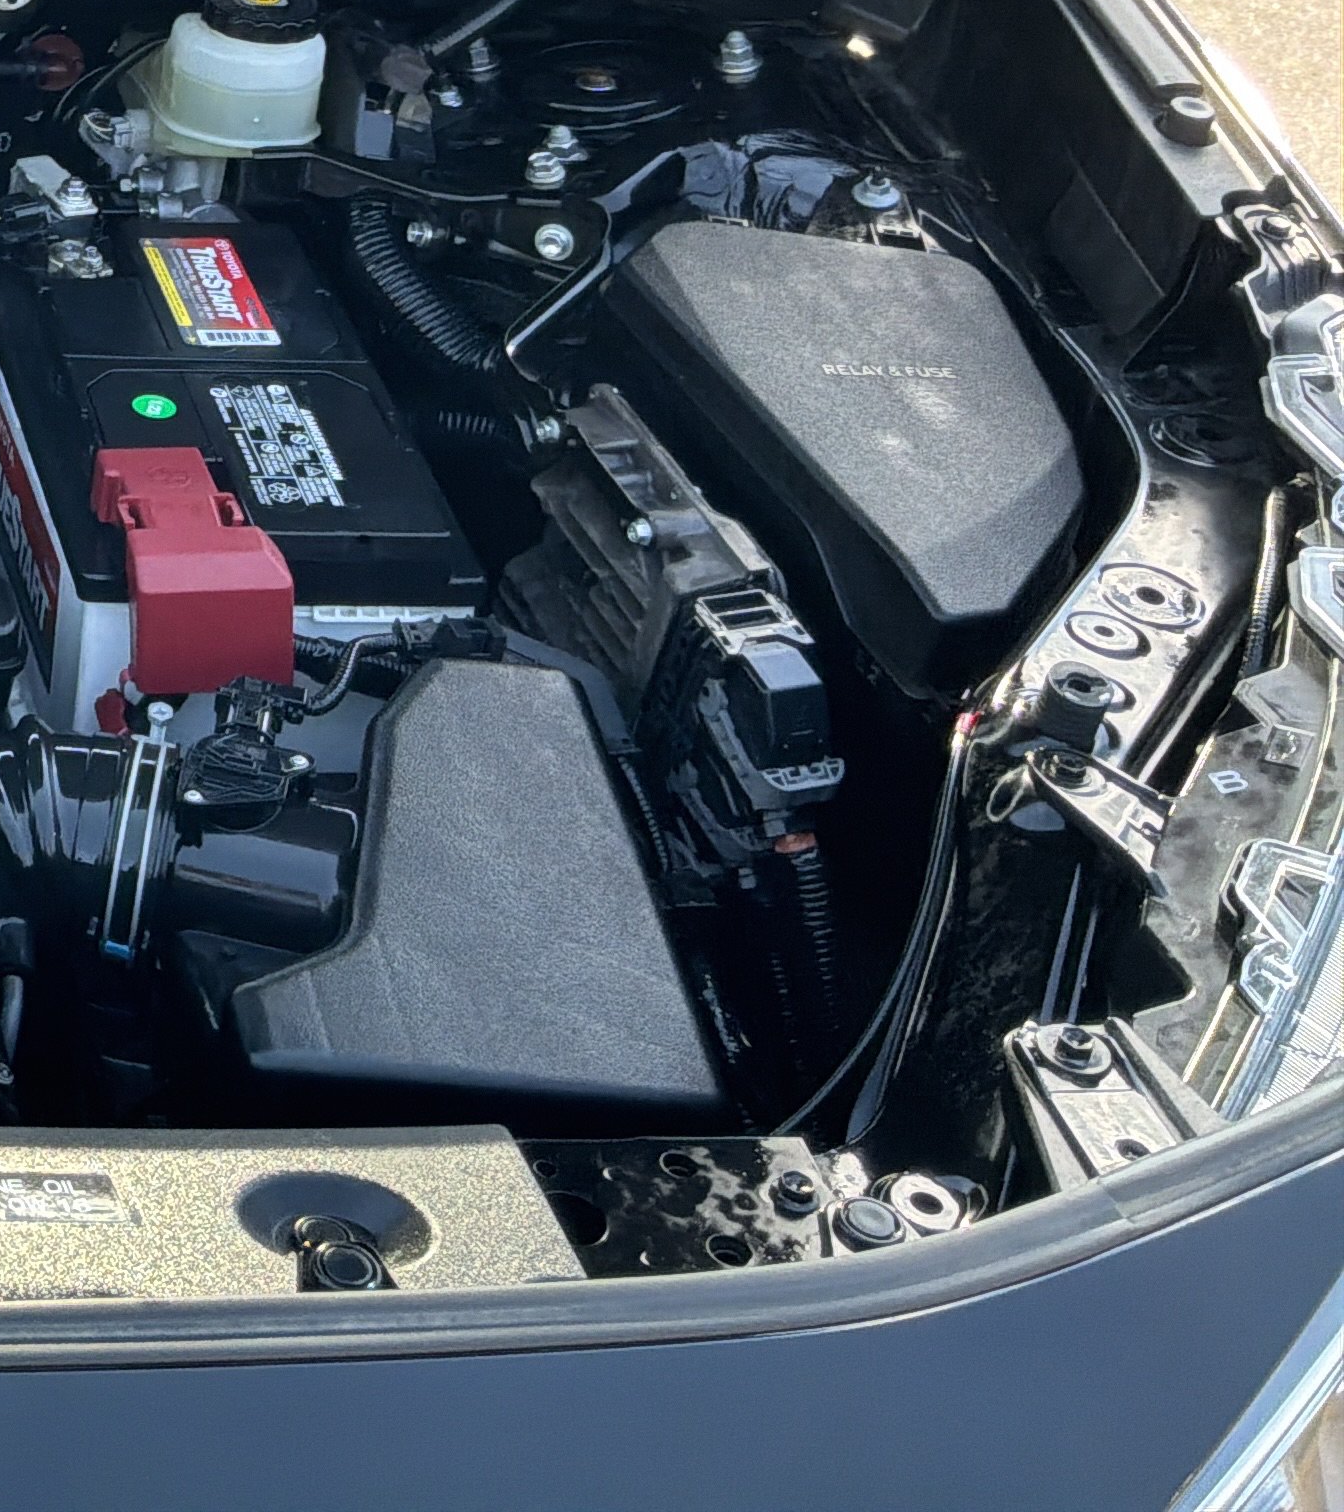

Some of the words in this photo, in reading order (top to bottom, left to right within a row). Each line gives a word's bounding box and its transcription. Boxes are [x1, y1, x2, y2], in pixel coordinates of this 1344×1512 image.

[221, 250, 243, 279] TOYOTA
[821, 363, 884, 377] RELAY
[888, 365, 904, 377] &
[905, 366, 958, 379] FUSE
[42, 1179, 86, 1195] OIL
